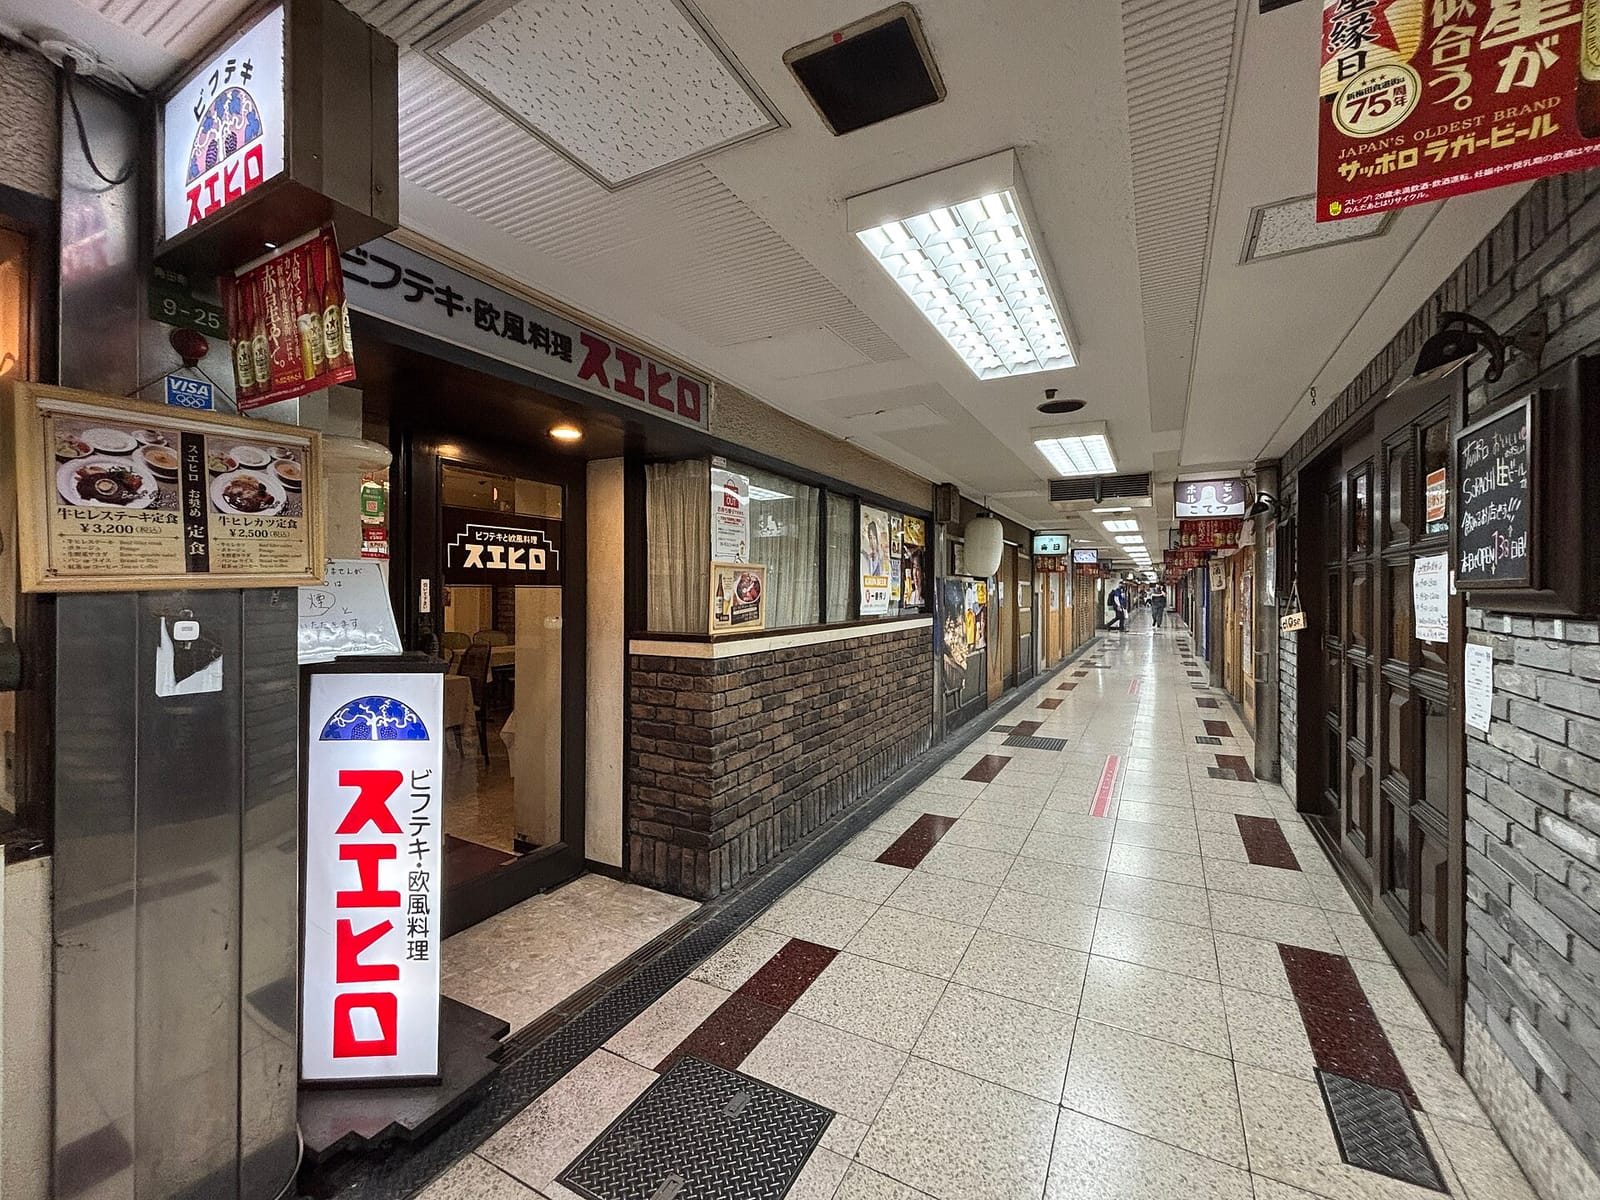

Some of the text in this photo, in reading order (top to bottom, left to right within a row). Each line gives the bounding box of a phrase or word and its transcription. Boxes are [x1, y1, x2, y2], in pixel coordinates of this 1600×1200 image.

[194, 58, 254, 123] ビフテキ
[1344, 89, 1392, 124] 75
[1338, 96, 1562, 159] JAPAN'S OLDEST BRAND
[1337, 114, 1560, 182] サッポロ ラガービール
[186, 143, 264, 229] スエヒロ
[162, 299, 221, 330] 9-25
[169, 378, 209, 397] VISA
[577, 331, 701, 422] スエヒロ
[187, 444, 199, 482] スエヒロ
[1186, 484, 1197, 504] ホル
[56, 508, 179, 524] 牛ヒレステーキ定食
[217, 515, 298, 529] 牛ヒレカツ定食
[1190, 505, 1229, 515] こてつ
[80, 523, 134, 534] ¥3,200
[187, 524, 206, 556] 定食
[229, 529, 268, 539] ¥2,500
[475, 531, 538, 545] ビフテキと欧風料理
[462, 543, 546, 571] スエヒロ
[405, 768, 433, 962] ビフテキ・欧風料理
[333, 769, 404, 1058] スエヒロ
